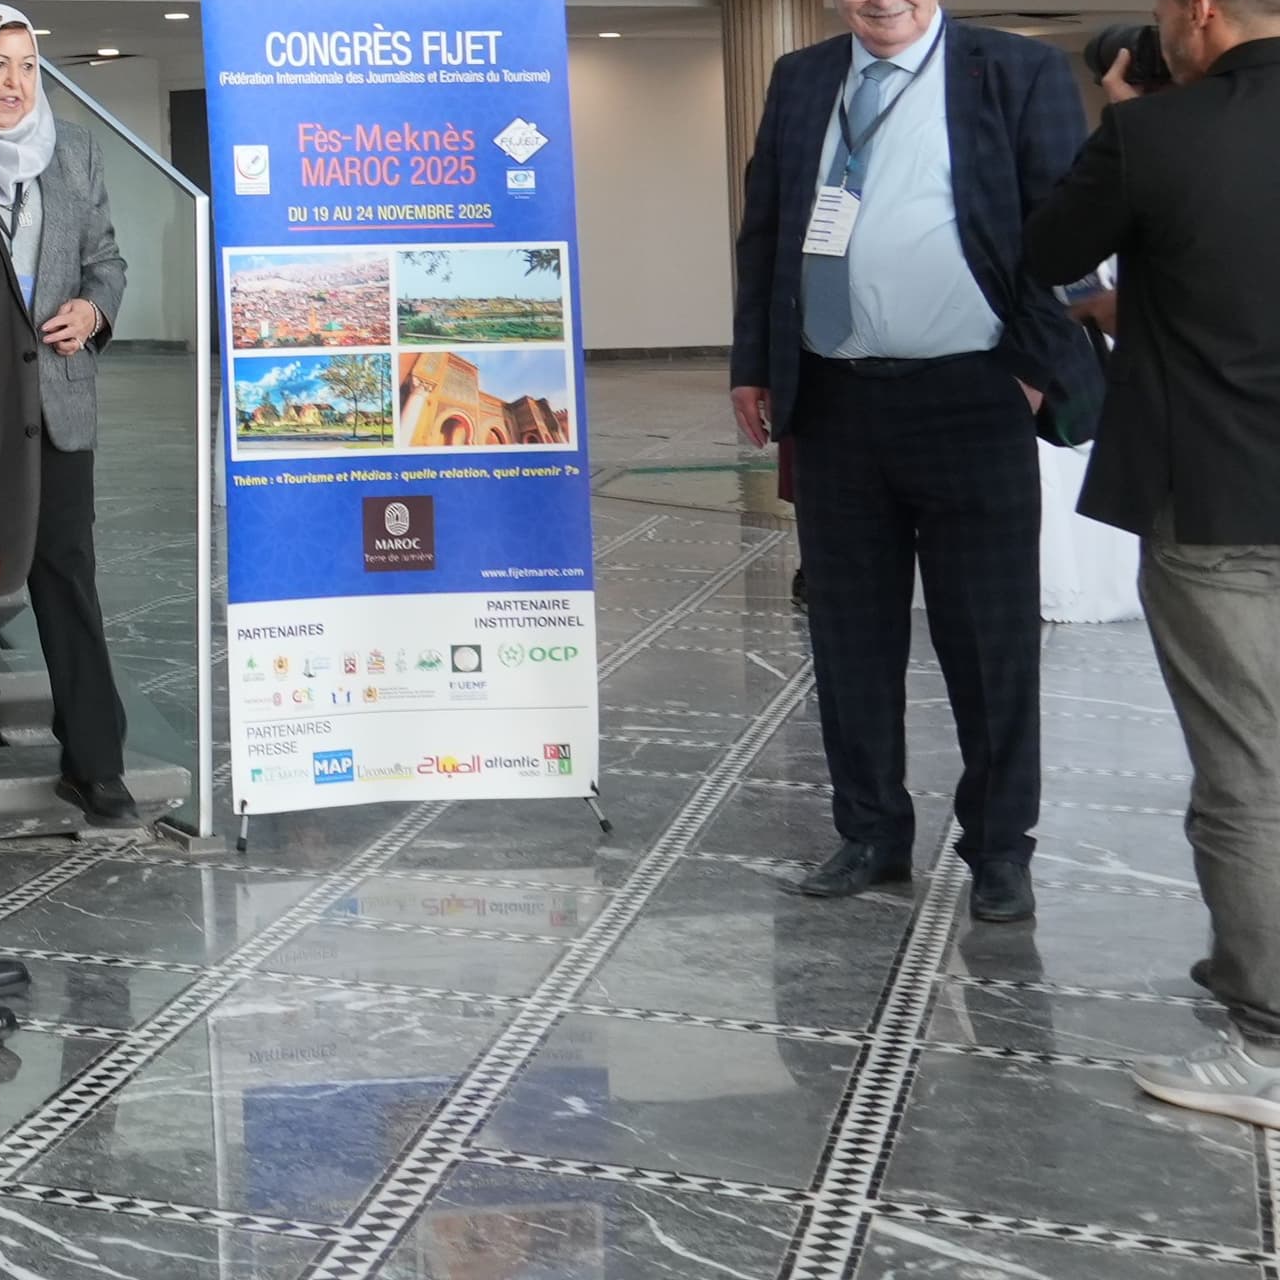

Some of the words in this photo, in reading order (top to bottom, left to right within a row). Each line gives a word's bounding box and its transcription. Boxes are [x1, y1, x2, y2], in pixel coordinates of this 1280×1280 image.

[265, 23, 412, 67] CONGRÈS
[422, 31, 503, 66] FIJET
[276, 71, 343, 85] Internationale
[346, 71, 368, 84] des
[367, 71, 425, 84] Journalistes
[428, 71, 437, 83] et
[487, 70, 500, 82] du
[298, 122, 476, 153] Fès-Meknès
[301, 156, 401, 187] MAROC
[410, 156, 477, 186] 2025
[288, 206, 308, 222] DU
[313, 206, 329, 222] 19
[333, 206, 352, 221] AU
[357, 205, 374, 221] 24
[377, 204, 455, 221] NOVEMBRE
[458, 204, 492, 219] 2025
[336, 472, 349, 482] et
[351, 470, 392, 482] Médias
[401, 467, 437, 483] quelle
[493, 466, 520, 480] quel
[522, 464, 562, 477] avenir
[374, 537, 422, 551] MAROC
[486, 598, 571, 612] PARTENAIRE
[474, 615, 584, 629] INSTITUTIONNEL
[237, 623, 325, 641] PARTENAIRES
[528, 645, 579, 662] OCP
[246, 720, 332, 740] PARTENAIRES
[248, 740, 298, 757] PRESSE
[314, 757, 353, 776] MAP
[417, 754, 482, 778] الصباح
[484, 755, 540, 769] atlantic
